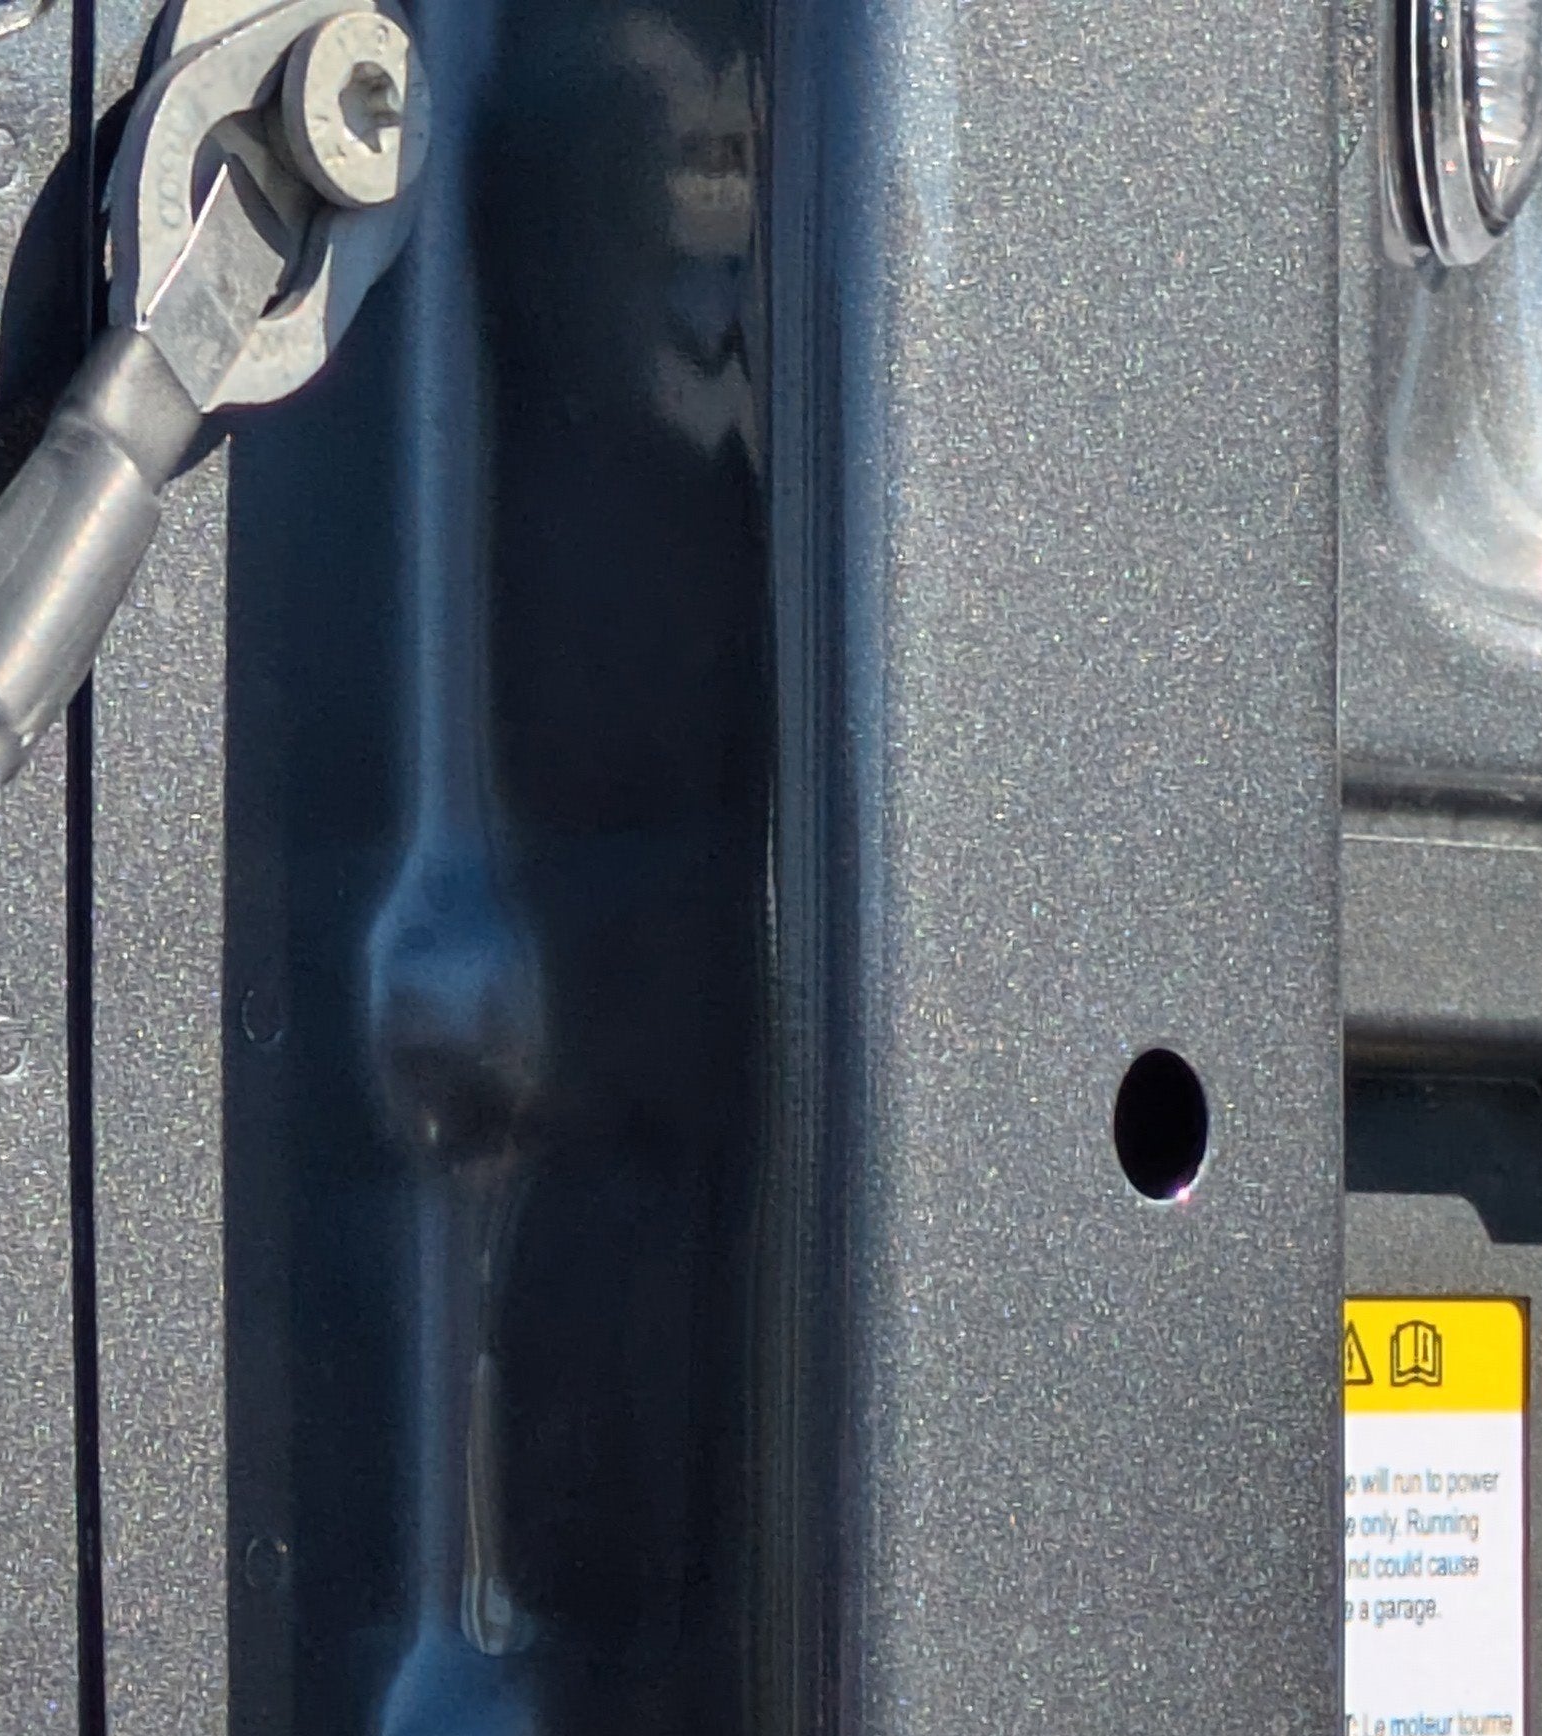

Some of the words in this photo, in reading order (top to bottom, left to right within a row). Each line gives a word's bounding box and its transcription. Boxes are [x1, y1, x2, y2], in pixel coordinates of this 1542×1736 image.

[1361, 1467, 1389, 1493] will
[1394, 1473, 1421, 1493] run
[1426, 1468, 1442, 1493] to
[1447, 1472, 1499, 1498] power
[1407, 1508, 1479, 1542] Running
[1375, 1551, 1422, 1578] could
[1428, 1555, 1479, 1577] cause
